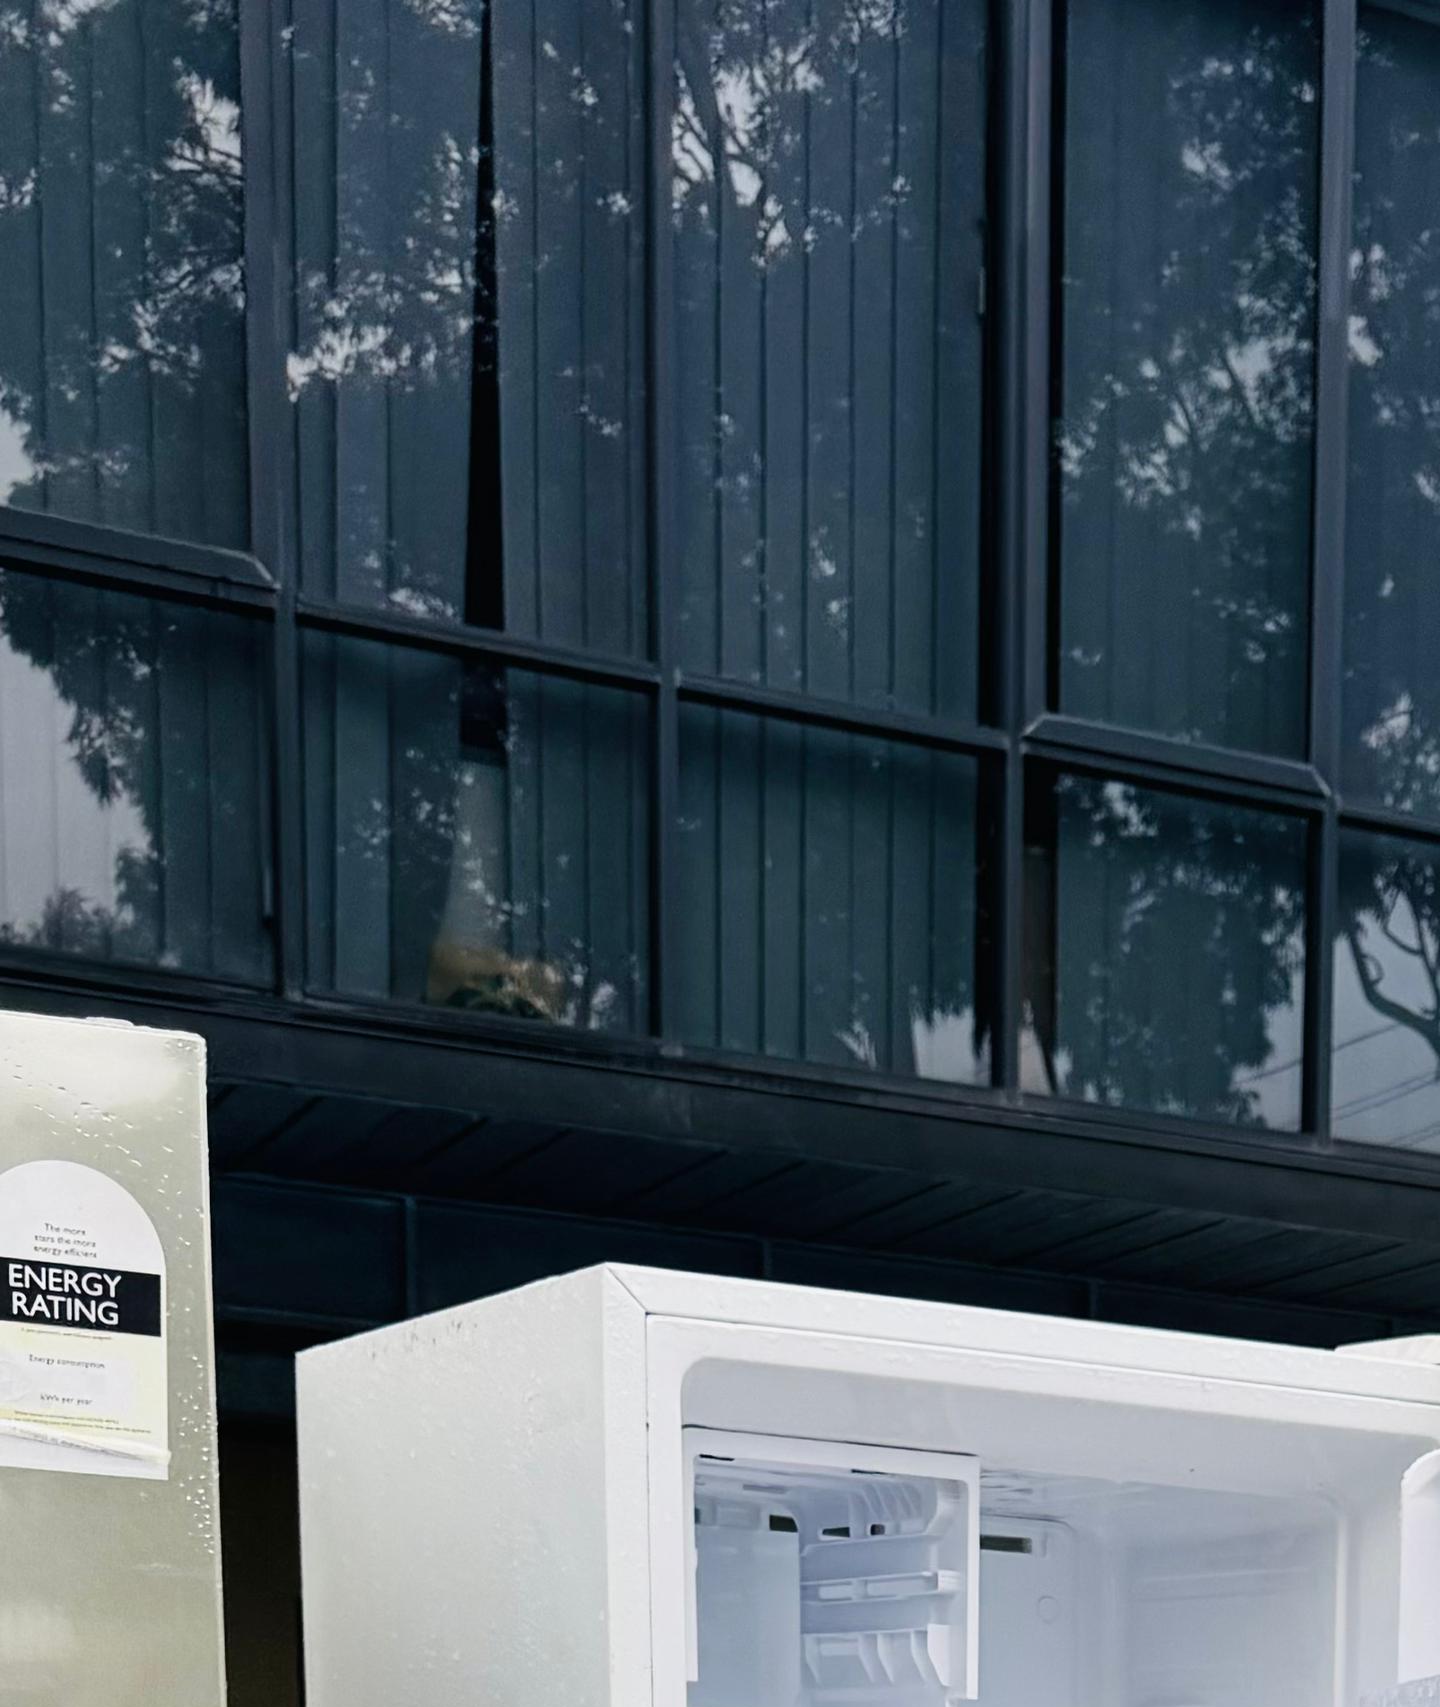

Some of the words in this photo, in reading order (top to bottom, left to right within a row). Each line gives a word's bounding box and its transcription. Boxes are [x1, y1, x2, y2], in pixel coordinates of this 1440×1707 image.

[44, 1222, 61, 1233] The
[63, 1227, 86, 1236] more
[8, 1263, 122, 1298] ENERGY
[11, 1291, 119, 1326] RATING
